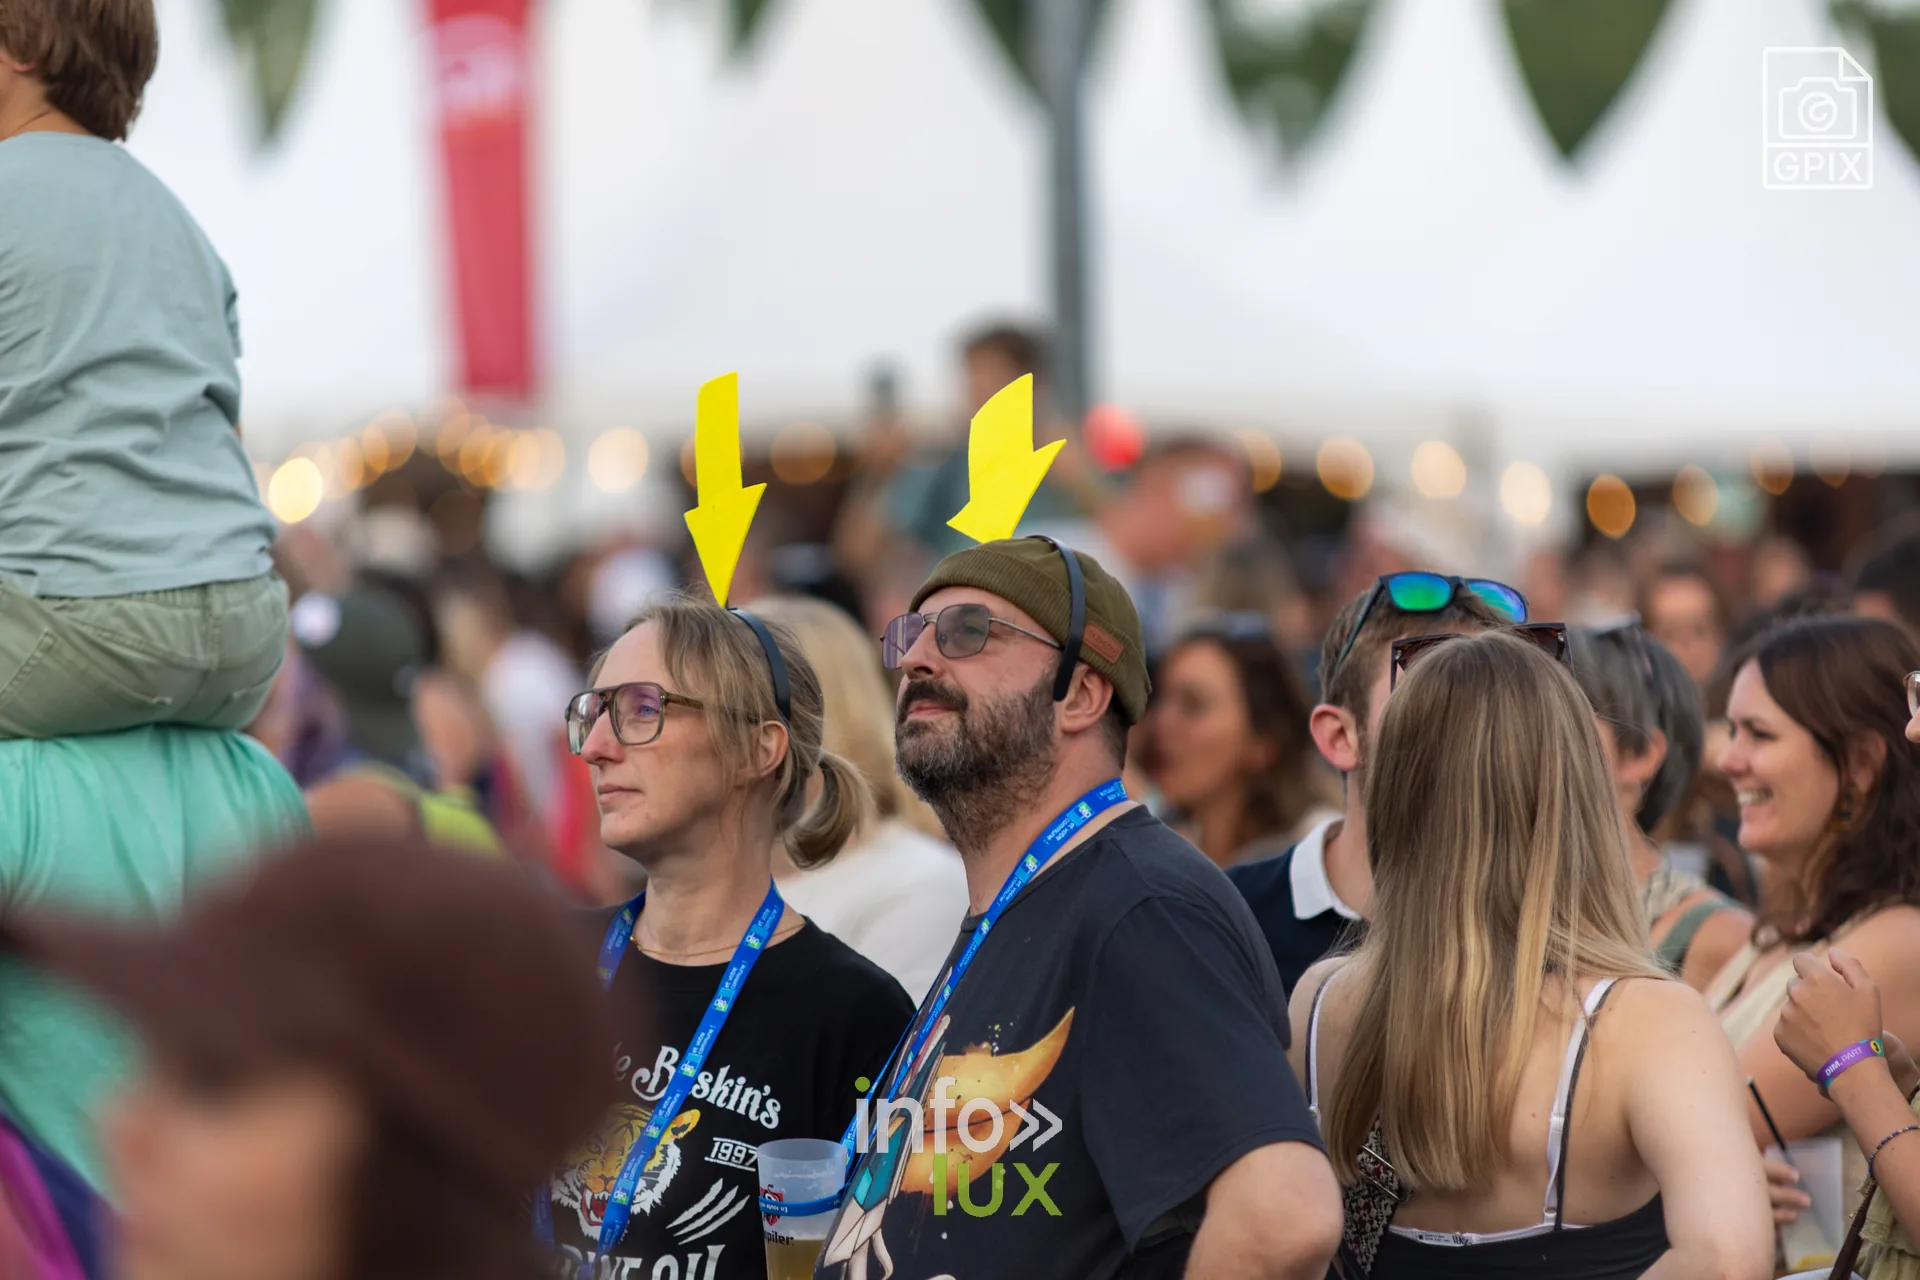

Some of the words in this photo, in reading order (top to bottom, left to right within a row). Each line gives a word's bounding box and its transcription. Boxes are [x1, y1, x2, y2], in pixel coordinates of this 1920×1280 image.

[1046, 818, 1070, 840] commune
[1056, 829, 1069, 841] votre
[999, 876, 1019, 902] commune
[1005, 887, 1017, 900] votre
[730, 967, 738, 980] votre
[731, 965, 746, 990] commune
[697, 1032, 705, 1046] votre
[699, 1029, 714, 1055] commune
[1825, 1060, 1843, 1076] DIM.
[631, 1046, 781, 1130] Bskin's
[663, 1096, 672, 1108] votre
[665, 1093, 680, 1118] commune
[711, 1140, 757, 1167] 1997
[766, 1230, 794, 1246] piler
